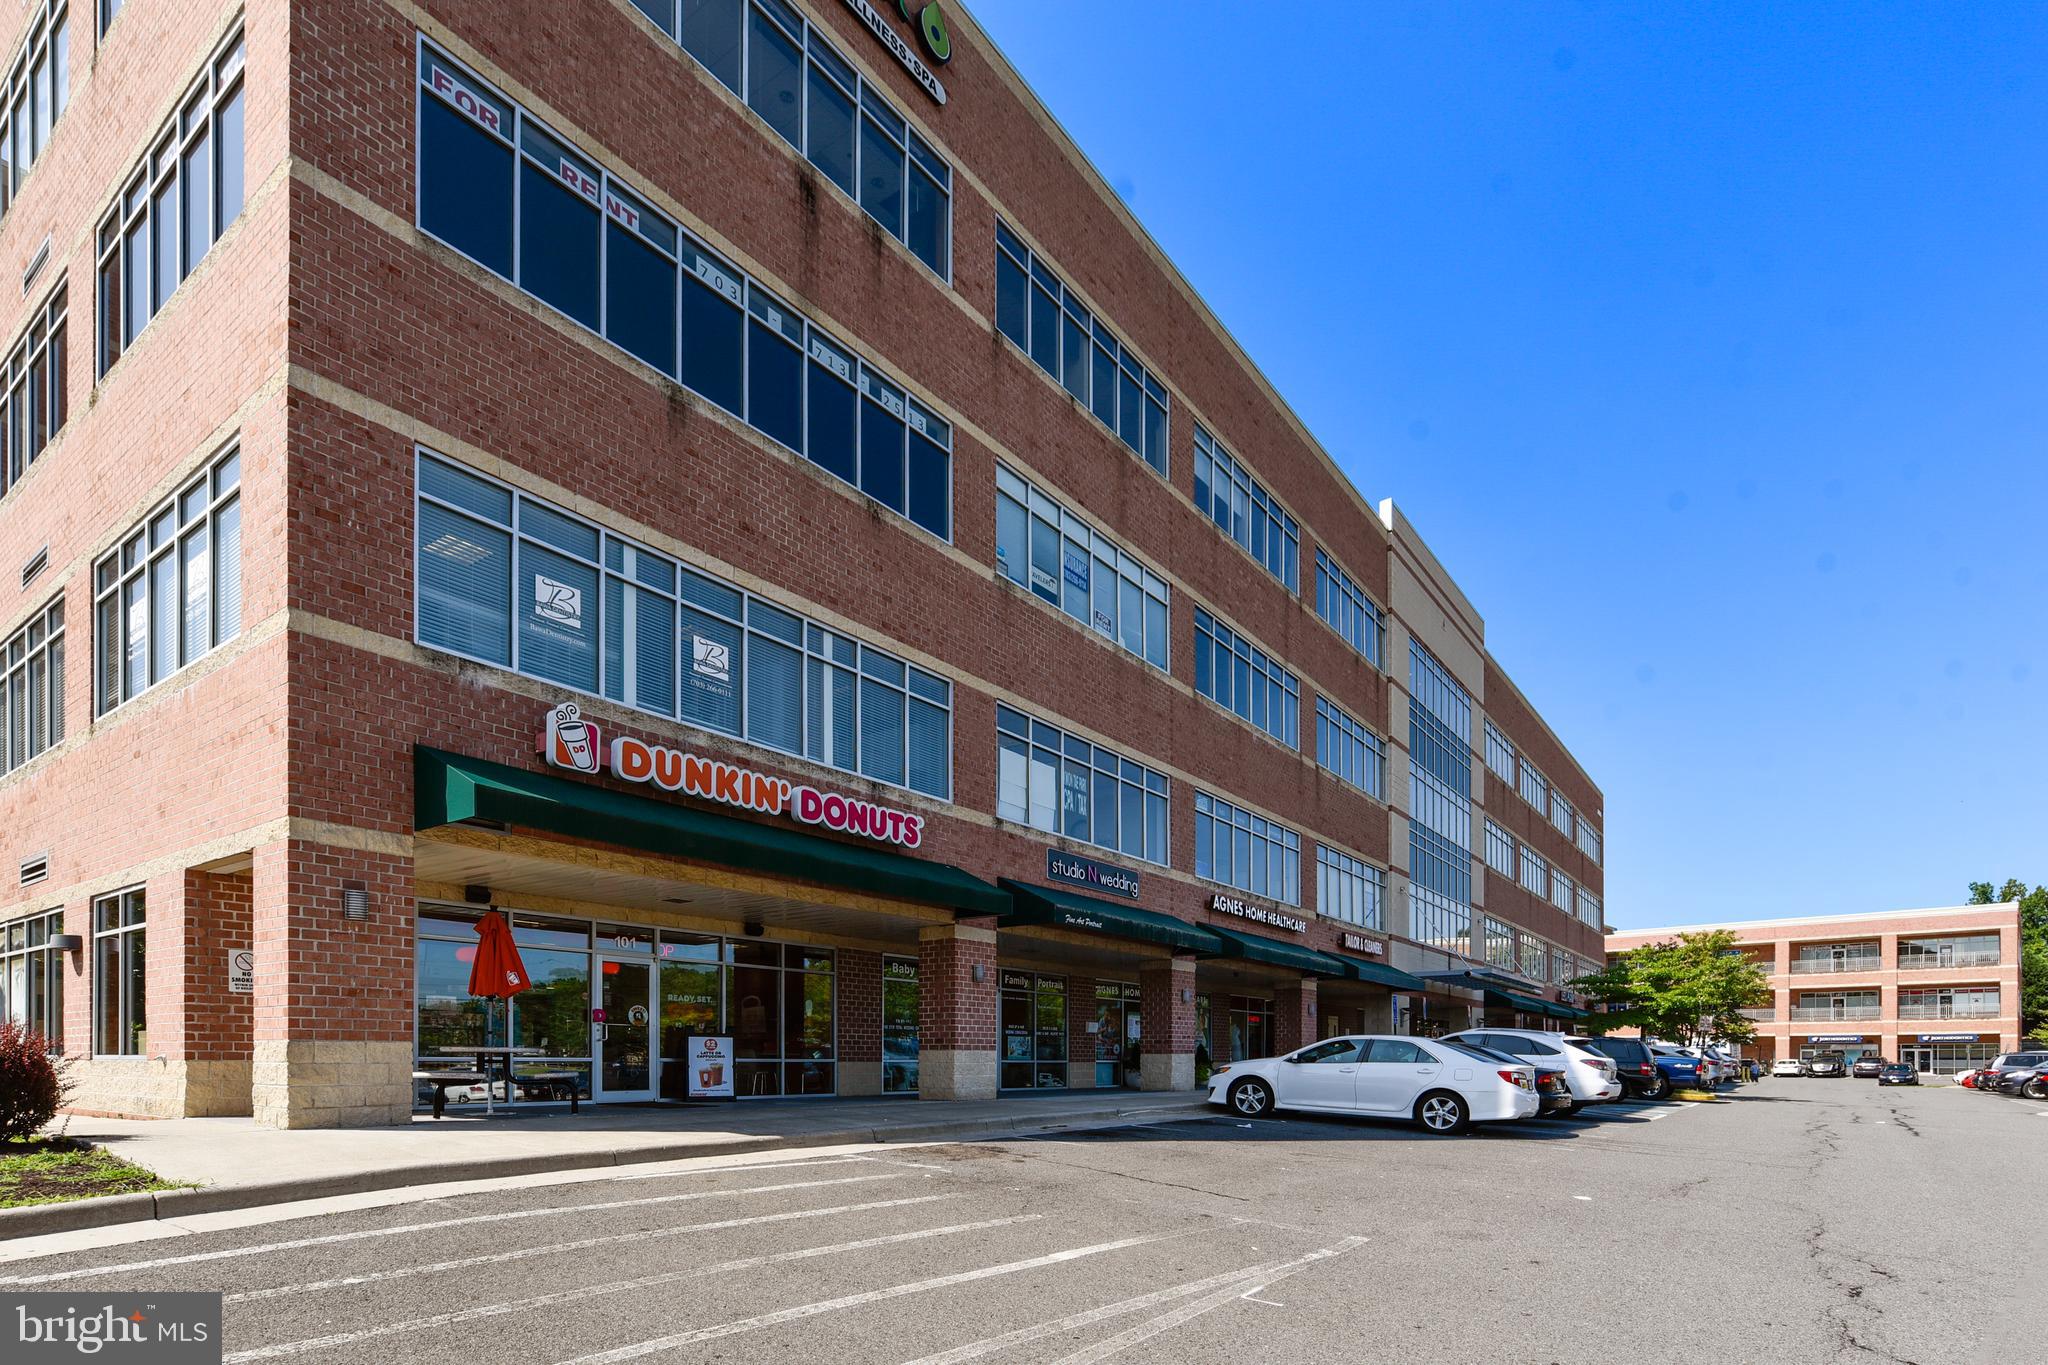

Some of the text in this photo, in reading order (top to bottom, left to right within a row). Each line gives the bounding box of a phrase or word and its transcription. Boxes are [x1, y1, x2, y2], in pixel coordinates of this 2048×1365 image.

[433, 68, 638, 228] FOR RENT
[699, 263, 738, 300] 703
[814, 345, 847, 377] 713
[621, 740, 921, 846] DUNKIN' DONUTS
[1052, 860, 1138, 897] studio N wedding
[1212, 894, 1307, 933] AGNES HOME HEALTHCARE
[614, 935, 637, 949] 101
[891, 962, 917, 977] Baby
[1004, 974, 1065, 990] Family Portrait
[1096, 985, 1141, 997] AGNES HOM
